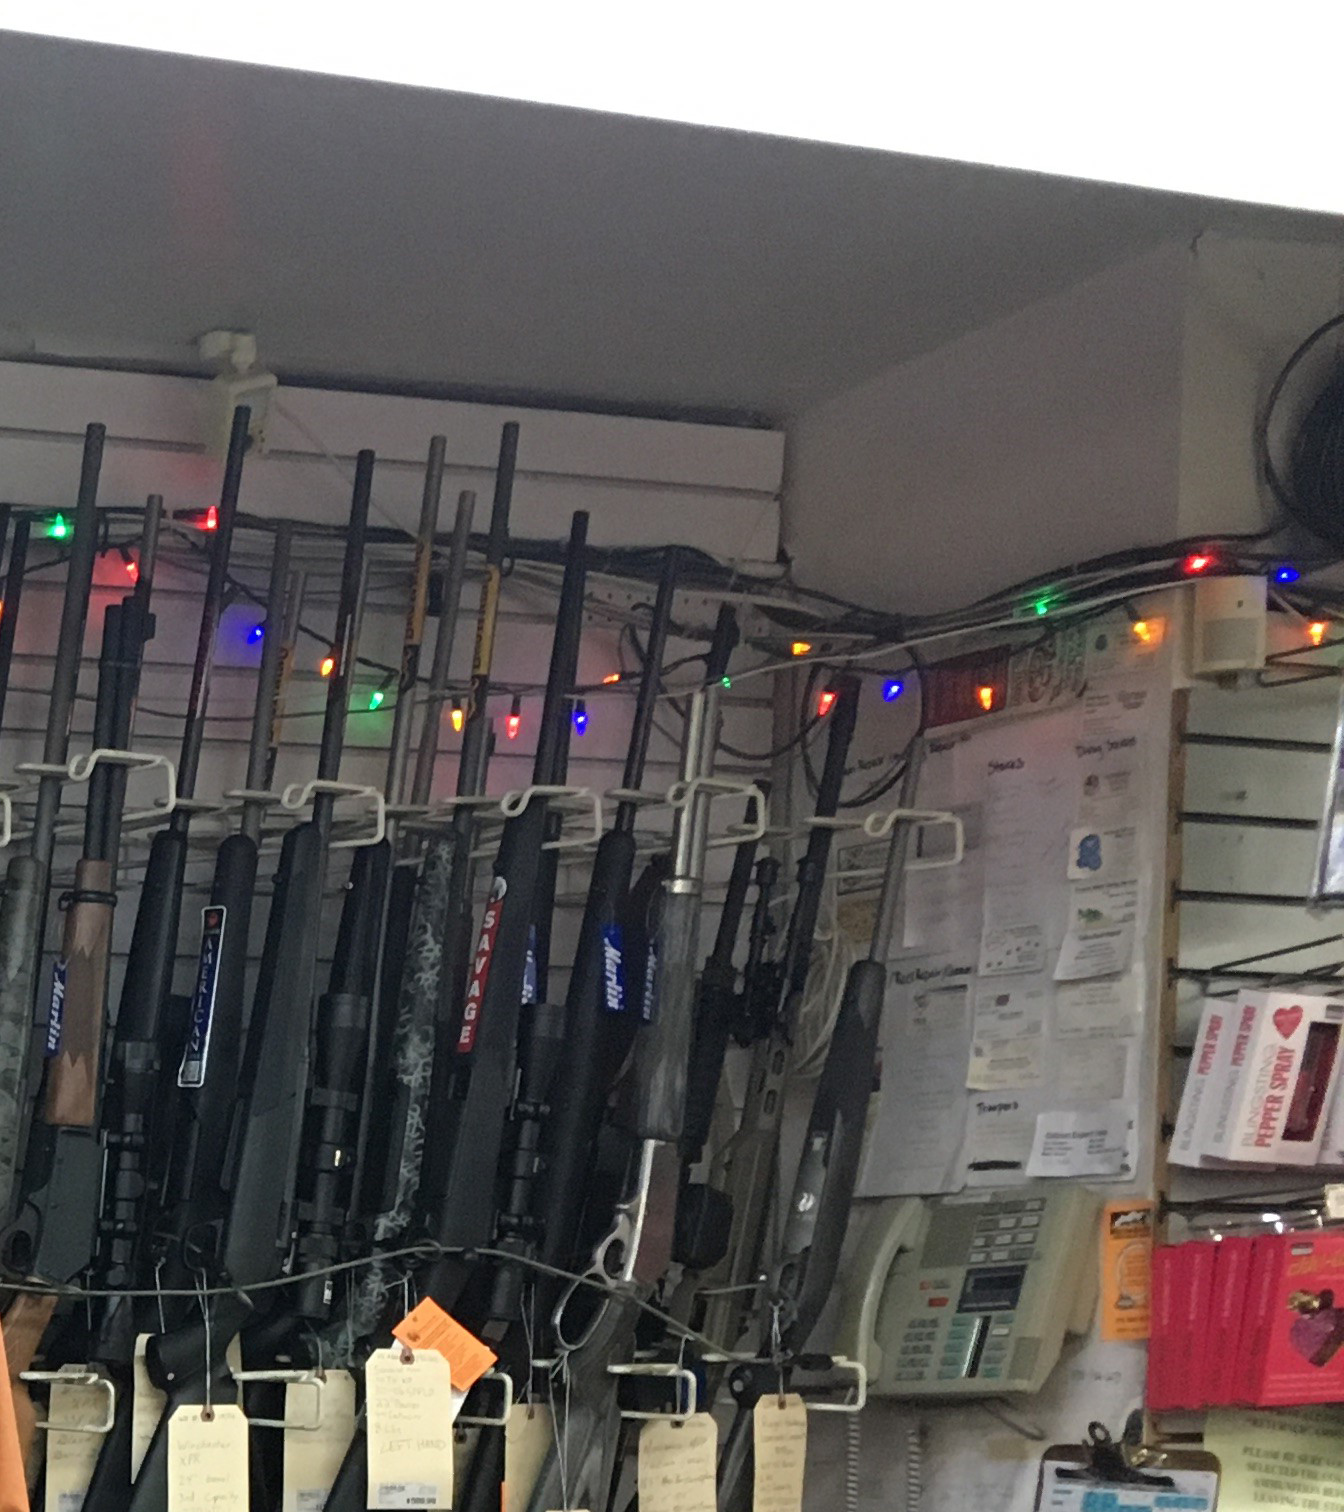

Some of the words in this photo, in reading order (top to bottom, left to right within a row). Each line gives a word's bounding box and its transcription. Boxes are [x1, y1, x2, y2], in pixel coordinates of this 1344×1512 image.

[47, 971, 65, 1051] Marlin
[458, 910, 497, 1044] SAVAGE
[603, 938, 622, 1011] Marlin
[1254, 1094, 1284, 1148] PEPPER
[1269, 1046, 1296, 1092] SPRAY
